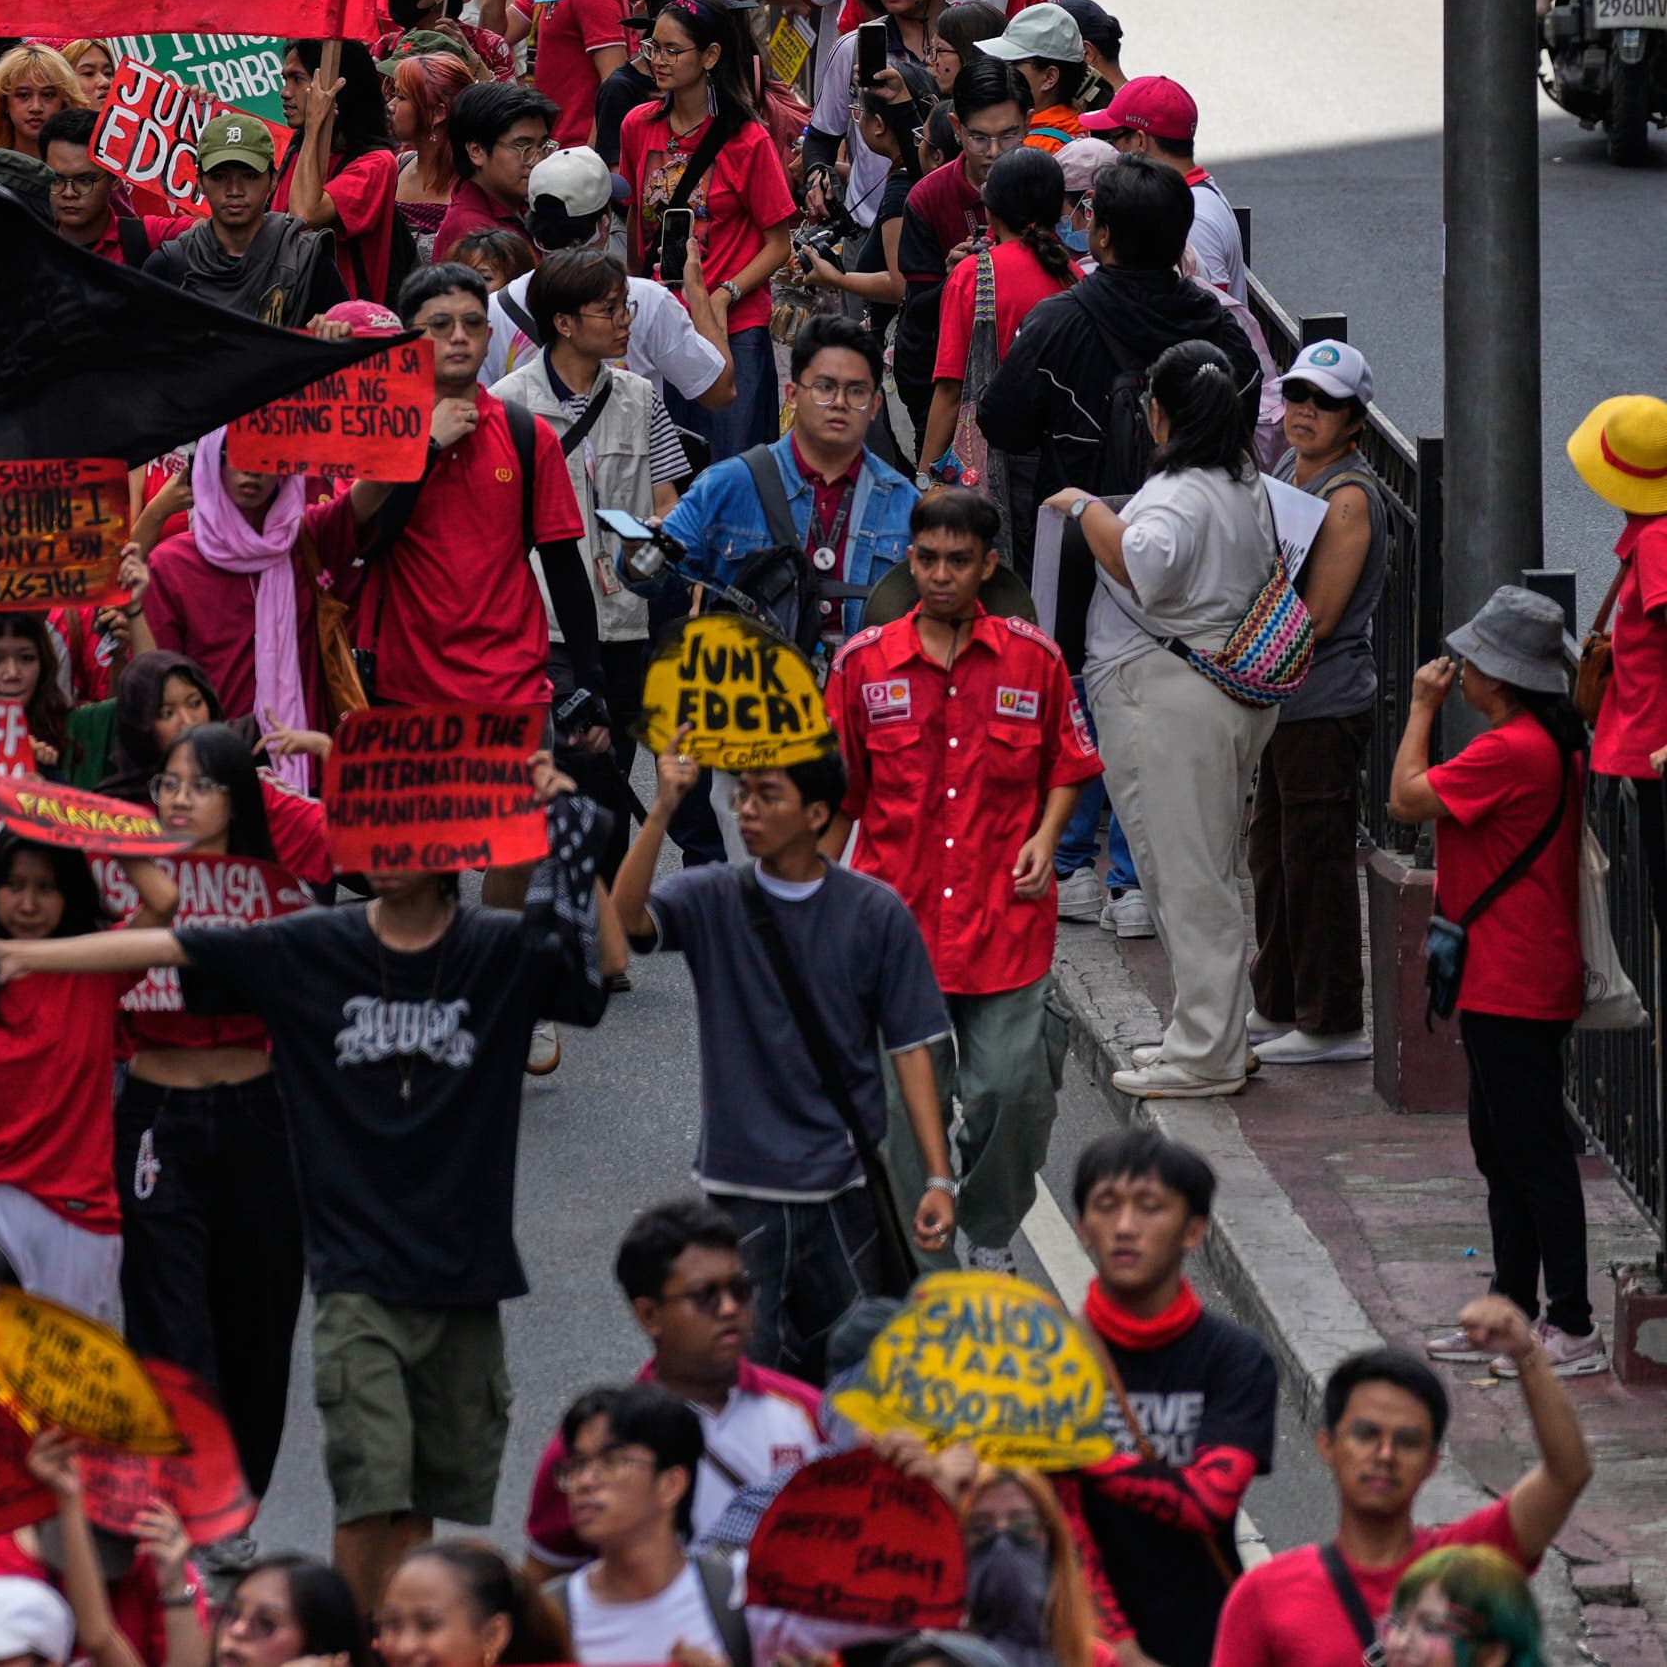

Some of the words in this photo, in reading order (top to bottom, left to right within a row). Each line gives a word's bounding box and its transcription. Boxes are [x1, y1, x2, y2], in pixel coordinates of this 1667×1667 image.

[119, 59, 214, 146] JUN
[94, 104, 205, 206] EDC
[400, 348, 422, 376] SA
[359, 376, 388, 403] NG
[342, 404, 423, 438] ESTADO
[68, 535, 103, 560] NG
[678, 634, 790, 694] JUNK
[676, 687, 816, 734] EDCA!
[338, 709, 459, 754] UPHOLD
[471, 712, 530, 748] THE
[327, 794, 488, 830] HUMANITARIAN
[370, 844, 415, 868] PUP
